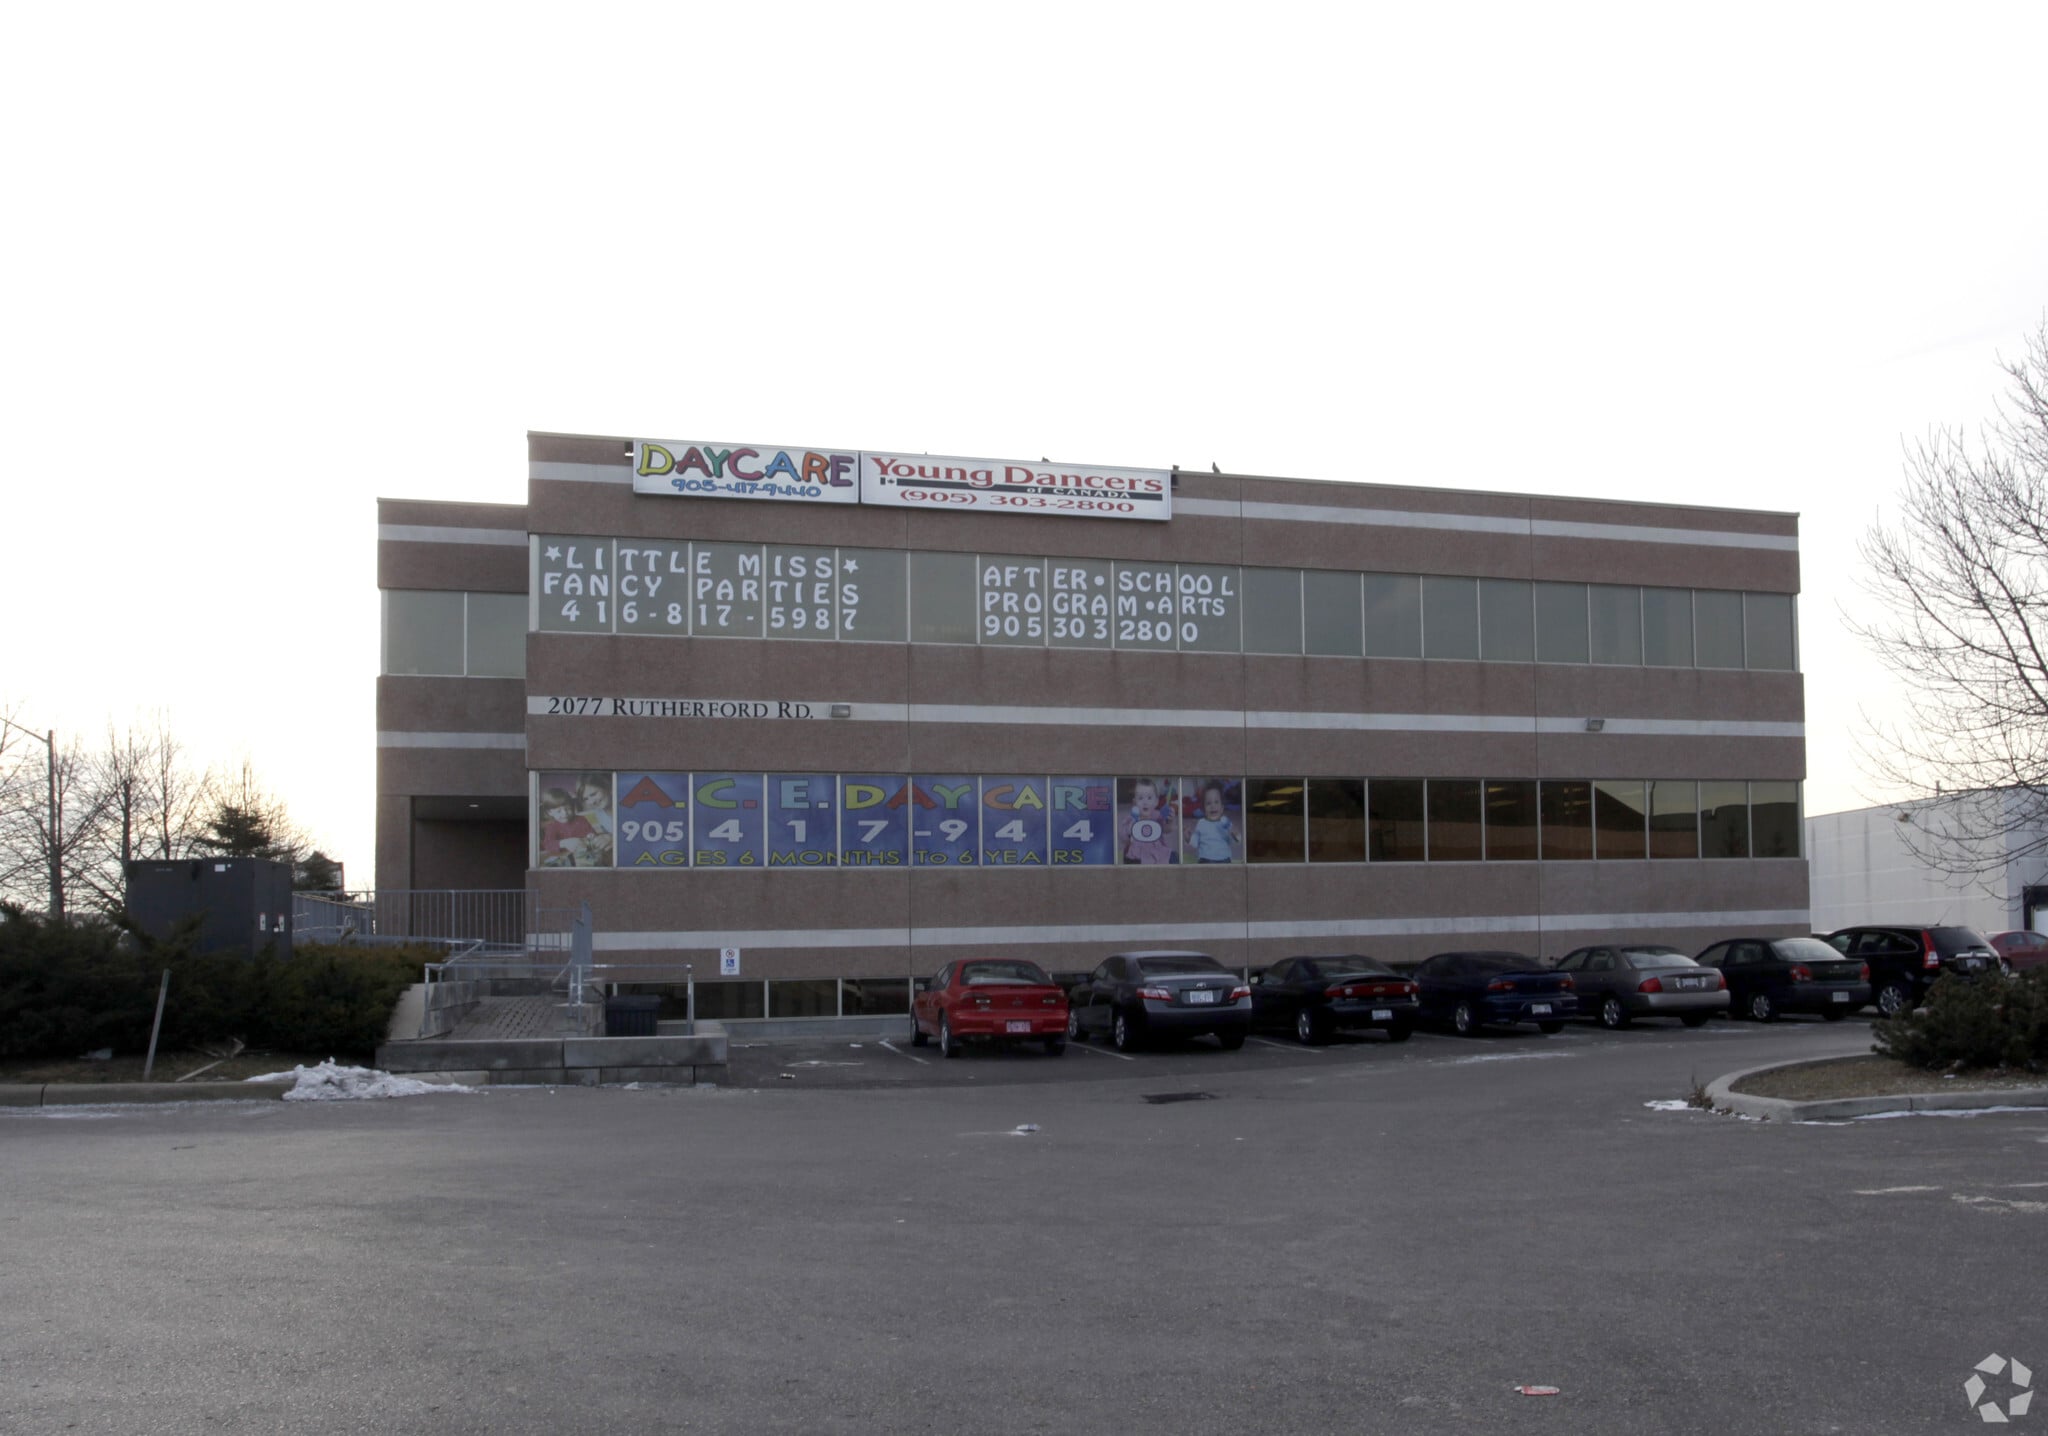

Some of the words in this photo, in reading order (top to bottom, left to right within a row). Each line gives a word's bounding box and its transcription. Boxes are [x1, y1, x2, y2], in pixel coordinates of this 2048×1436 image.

[637, 443, 854, 488] DAYCARE
[870, 456, 993, 488] Young
[1004, 466, 1163, 492] Dancers
[671, 478, 821, 498] 905-417-9440
[900, 488, 977, 505] (905)
[990, 494, 1134, 513] 303-2800
[1052, 487, 1131, 498] CANADA
[566, 546, 713, 575] LITTLE
[544, 572, 662, 596] FANCY
[697, 578, 859, 606] PARTIES
[984, 615, 1042, 637] 905
[1119, 620, 1199, 643] 2800
[547, 696, 603, 715] 2077
[612, 697, 769, 719] RUTHERFORD
[777, 701, 814, 720] RD.
[845, 783, 1111, 811] DAYCARE
[621, 820, 685, 842] 905
[635, 850, 728, 866] AGES
[738, 850, 756, 865] 6
[770, 849, 900, 866] MONTHS
[957, 849, 974, 864] 6
[984, 849, 1084, 864] YEARS
